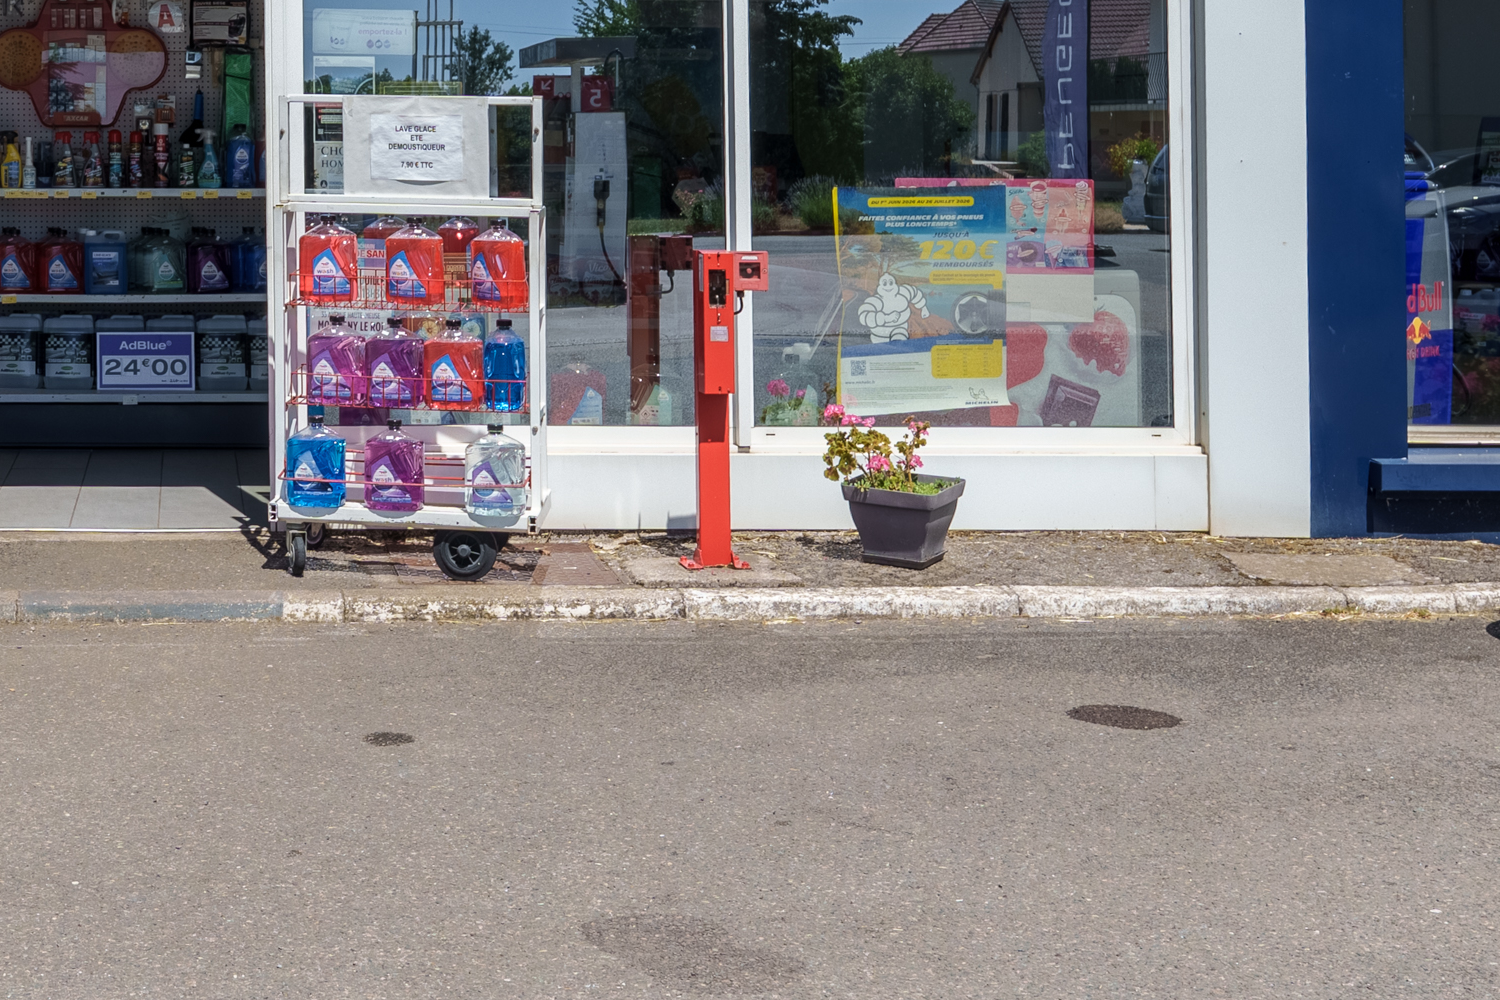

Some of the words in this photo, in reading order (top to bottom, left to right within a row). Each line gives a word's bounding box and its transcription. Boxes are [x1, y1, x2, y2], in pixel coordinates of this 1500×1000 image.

[395, 125, 412, 133] LAVE
[414, 125, 437, 133] GLACE
[410, 134, 423, 142] ETE
[388, 142, 446, 151] DEMOUSTIQUEUR
[400, 161, 414, 169] 7,90
[420, 161, 434, 169] TTC
[932, 260, 994, 268] REMBOURSÉS
[360, 321, 368, 332] LE
